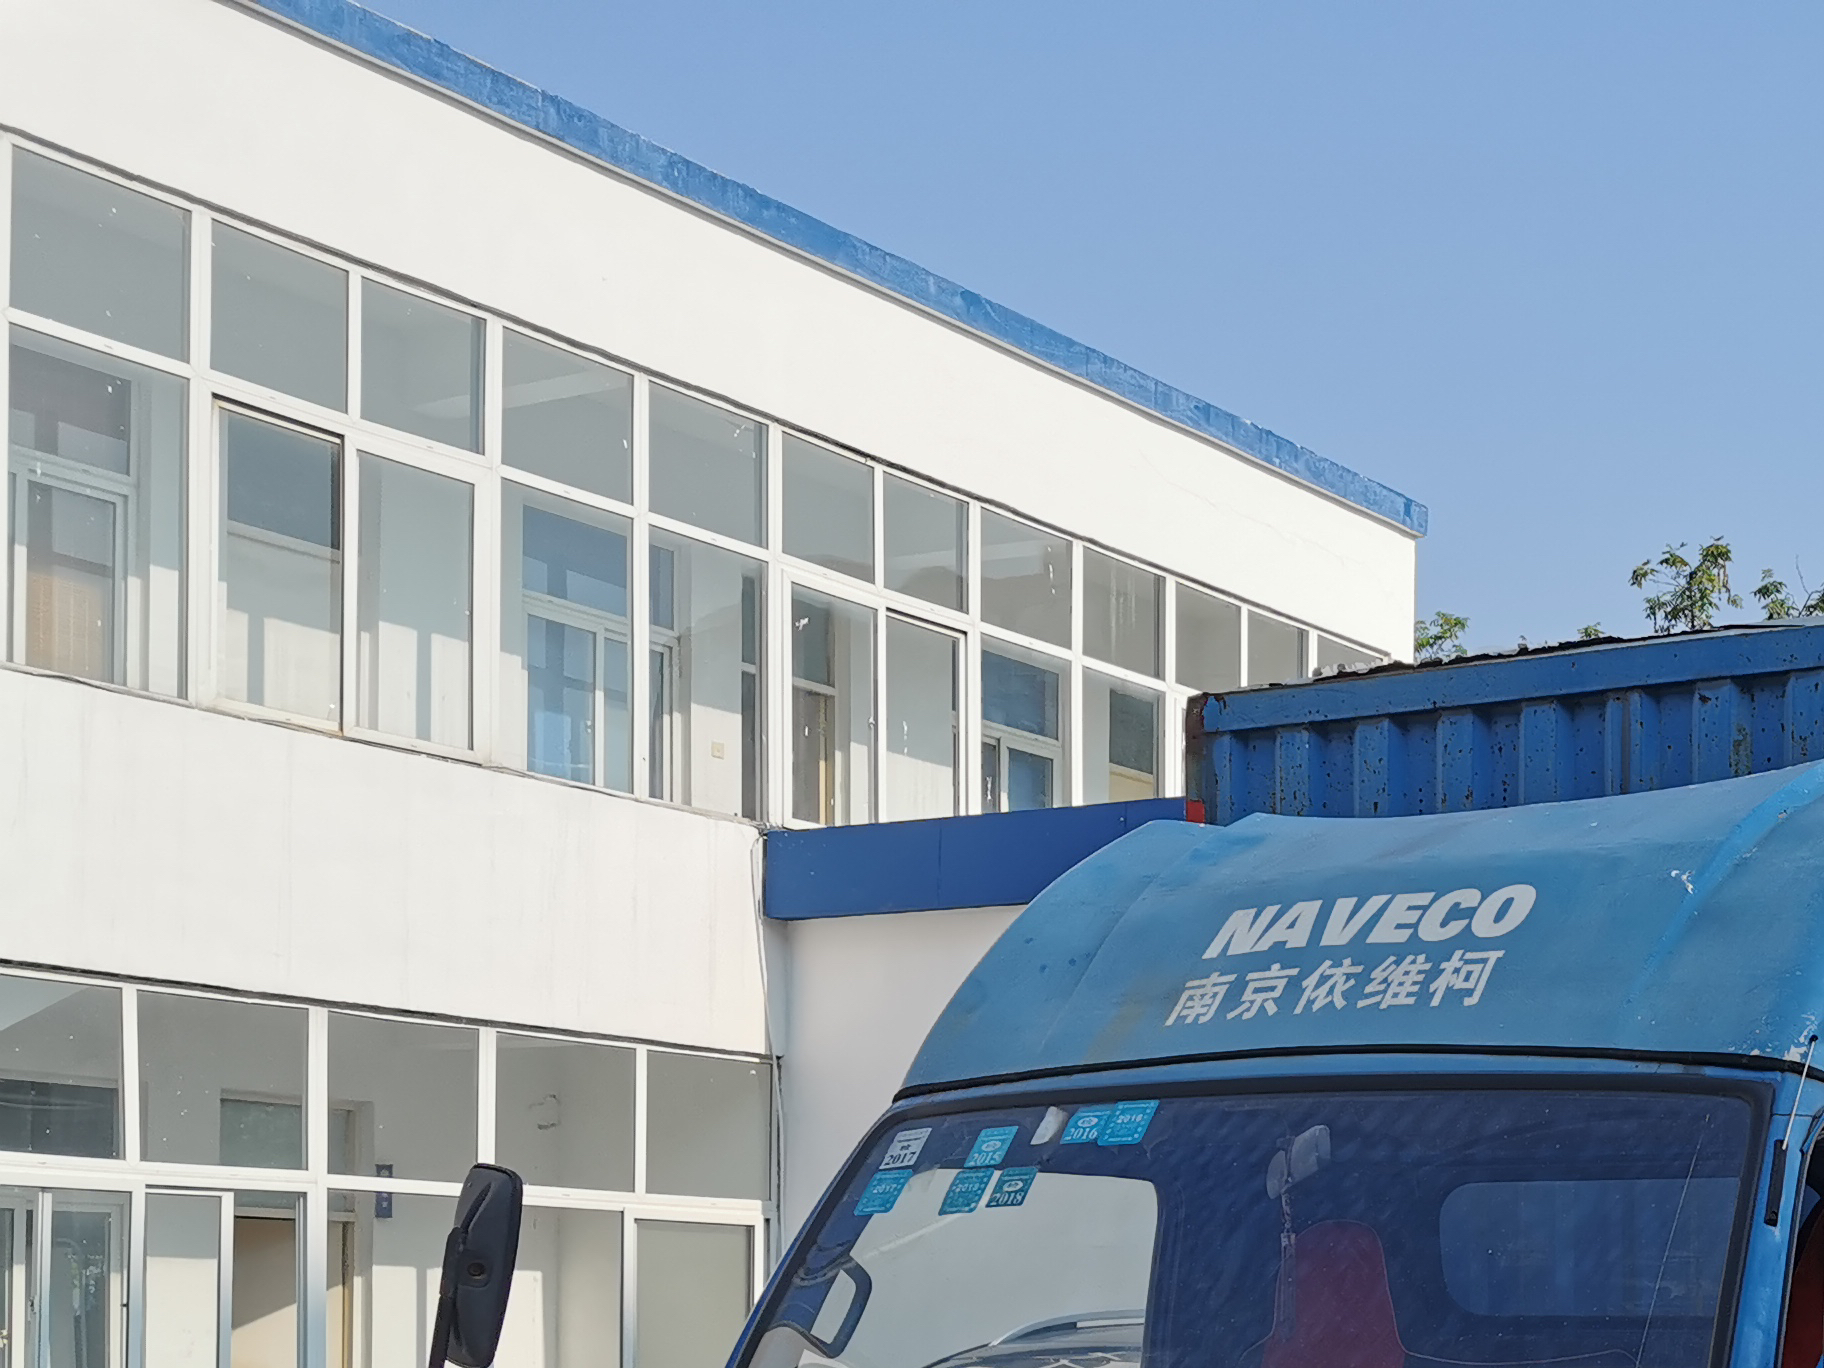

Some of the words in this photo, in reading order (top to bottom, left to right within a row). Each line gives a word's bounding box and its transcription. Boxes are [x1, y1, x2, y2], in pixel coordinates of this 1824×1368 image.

[1202, 884, 1537, 960] NAVECO
[1164, 949, 1505, 1026] 南京依维柯
[1064, 1128, 1099, 1140] 2016
[884, 1151, 916, 1166] 2017
[990, 1191, 1024, 1206] 2018
